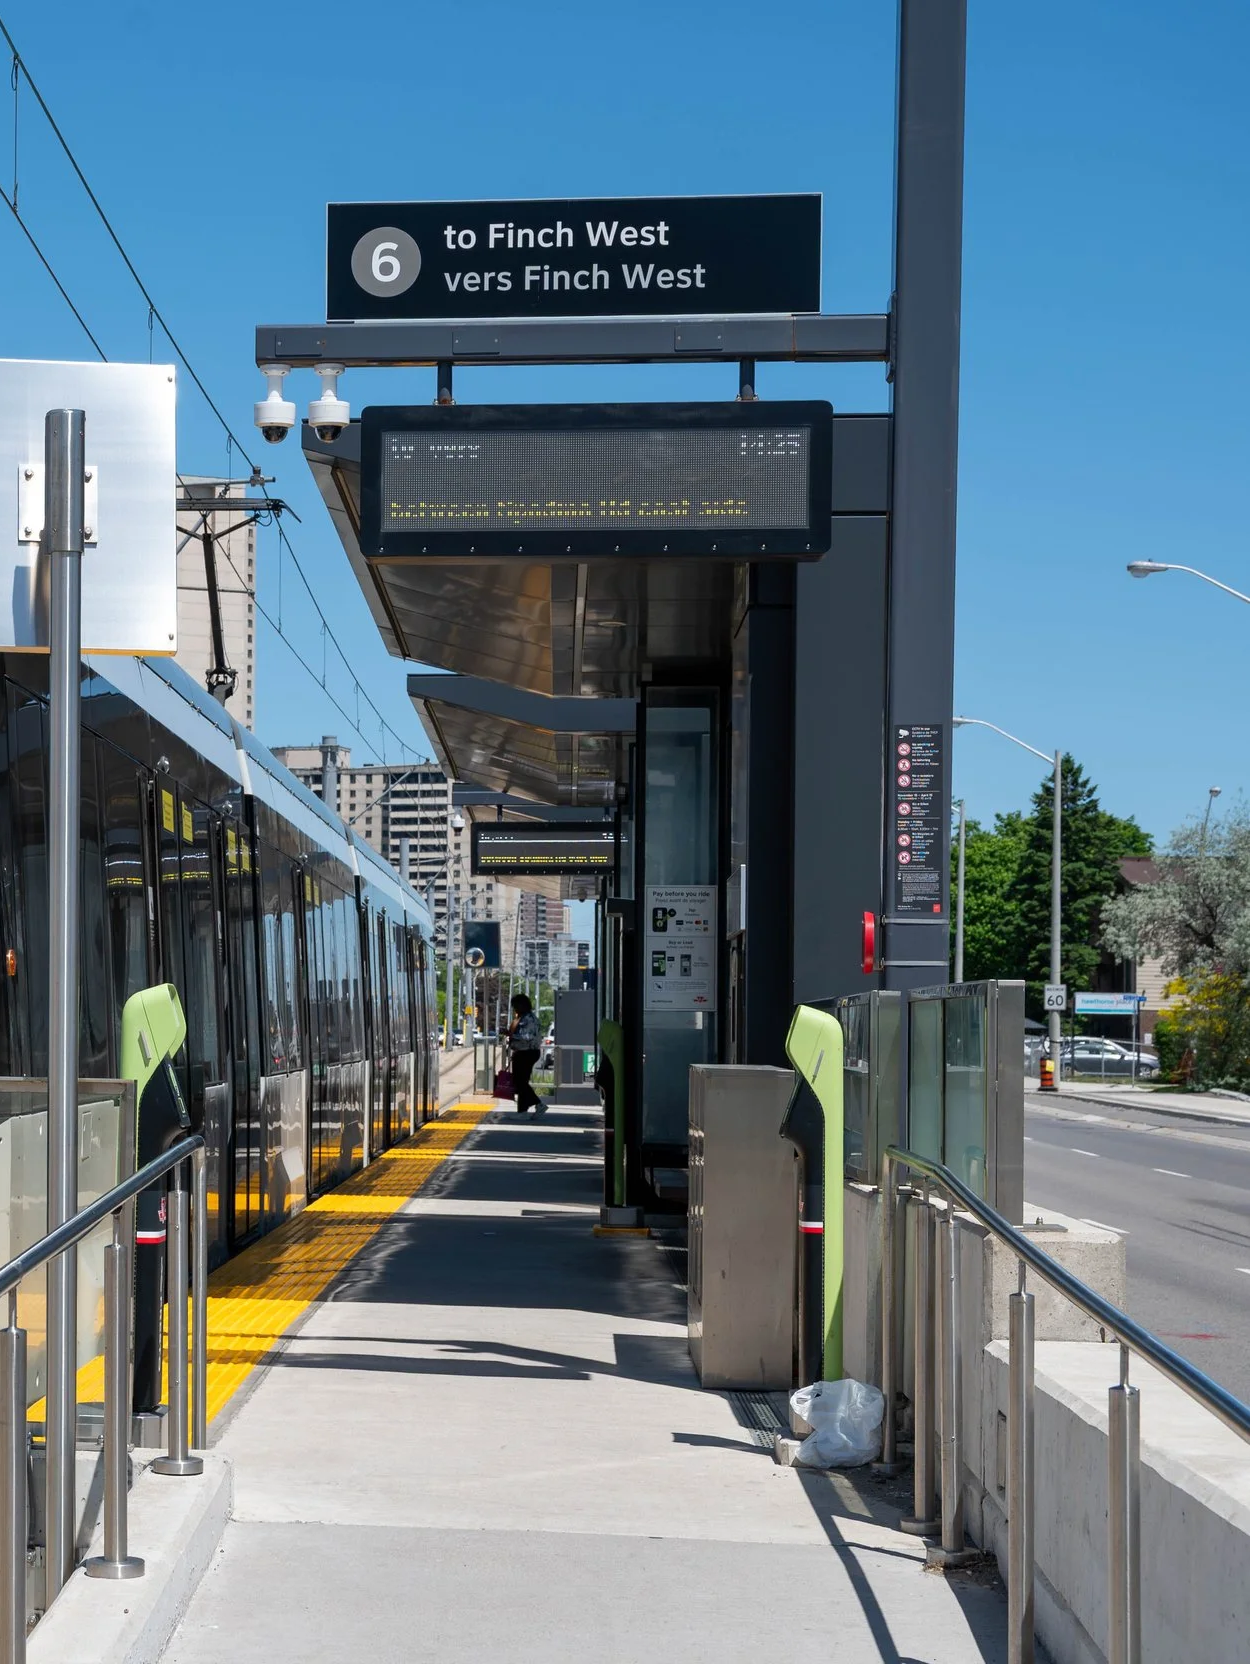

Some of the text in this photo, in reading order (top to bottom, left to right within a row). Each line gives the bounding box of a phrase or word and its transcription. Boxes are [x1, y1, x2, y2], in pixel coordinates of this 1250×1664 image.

[443, 221, 670, 250] to Finch West
[371, 241, 401, 283] 6
[443, 263, 706, 292] vers Finch West
[1046, 994, 1064, 1006] 60
